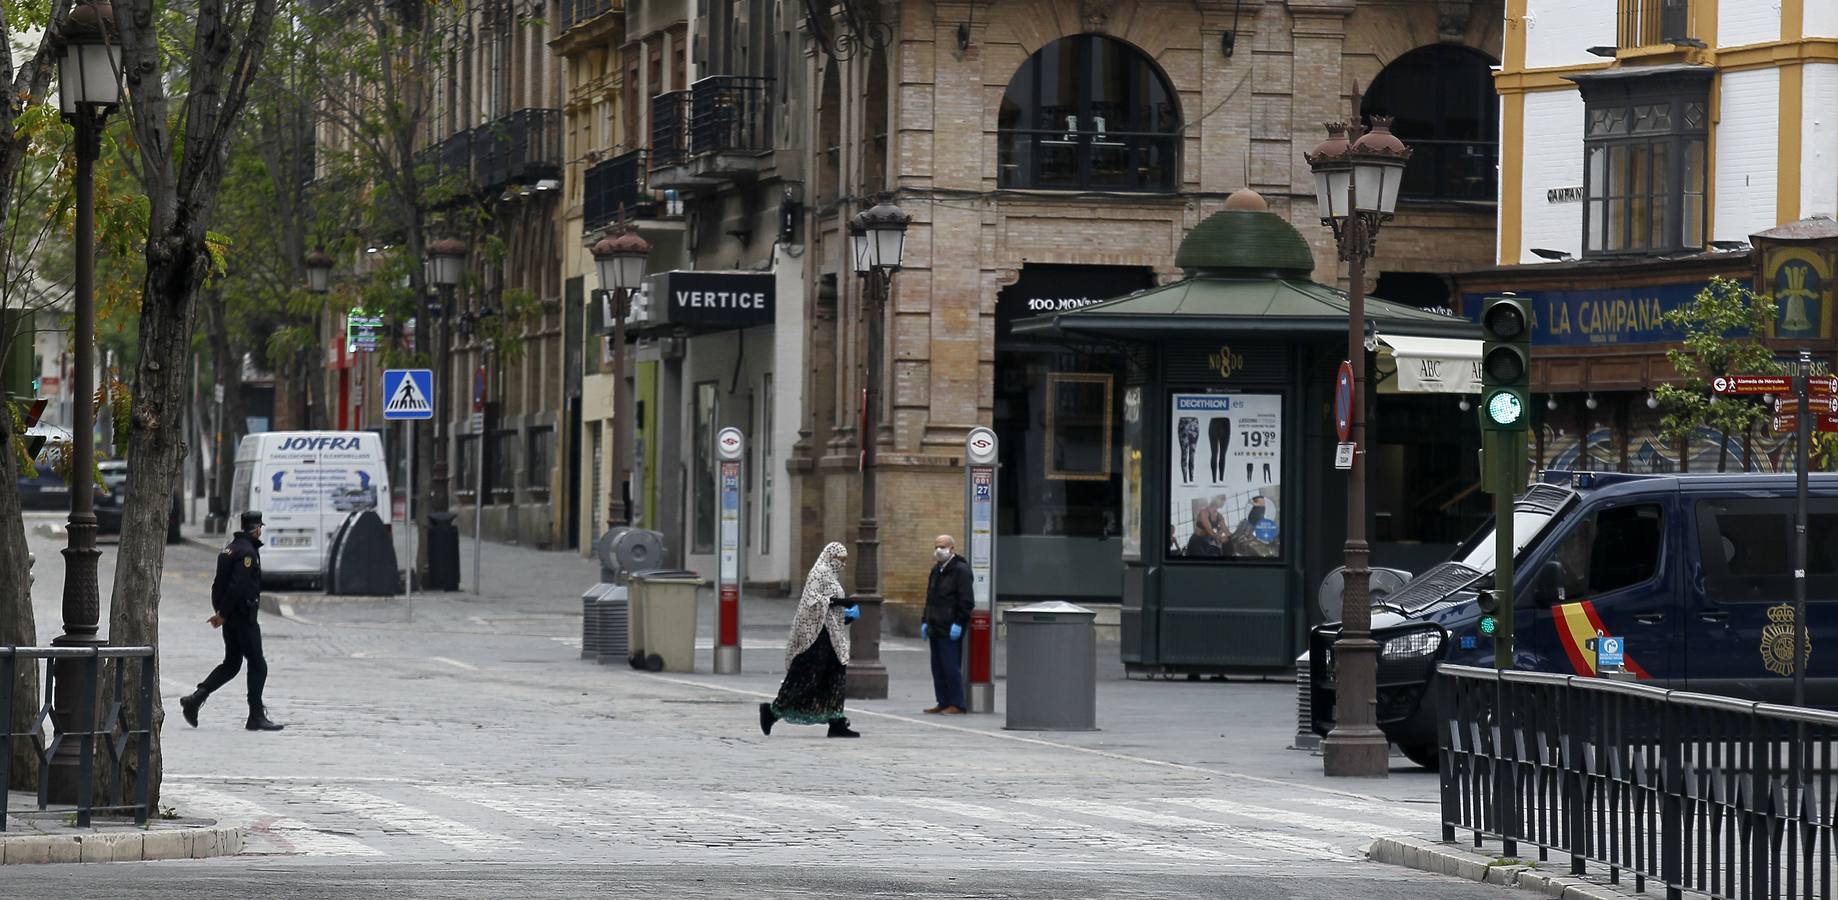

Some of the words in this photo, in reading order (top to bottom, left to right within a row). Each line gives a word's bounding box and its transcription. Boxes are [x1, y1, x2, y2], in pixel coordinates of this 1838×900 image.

[1547, 187, 1584, 203] CAMPAN
[676, 291, 765, 308] VERTICE
[1028, 298, 1054, 310] 100
[1549, 302, 1571, 334] LA
[1578, 298, 1664, 334] CAMPANA
[1420, 359, 1440, 378] ABC
[1180, 399, 1227, 408] DECATHLON
[278, 437, 361, 450] JOYFRA
[977, 486, 988, 494] 27
